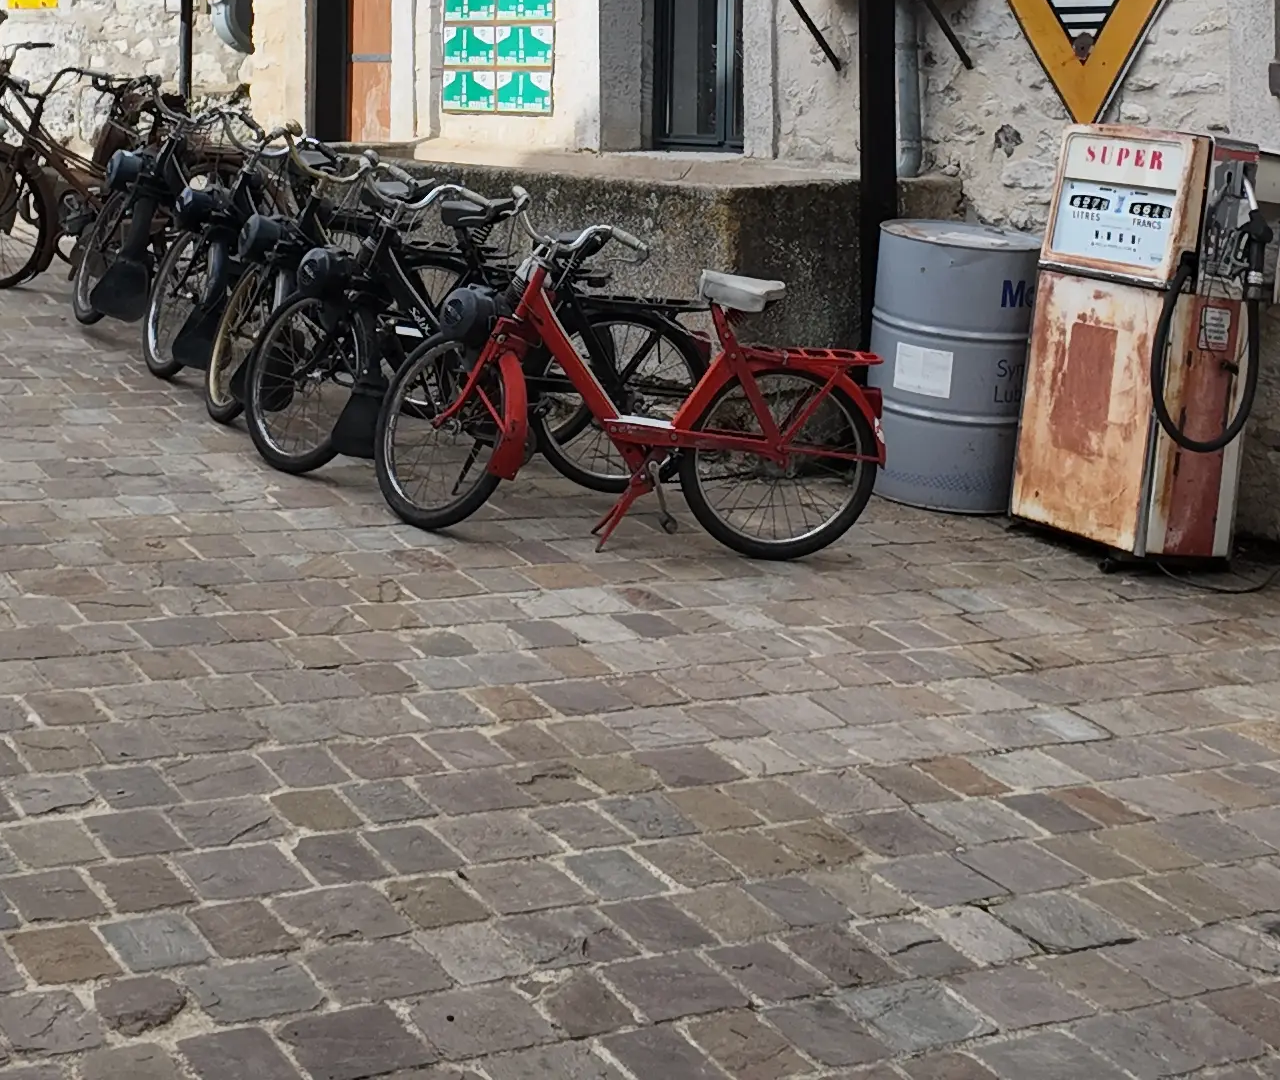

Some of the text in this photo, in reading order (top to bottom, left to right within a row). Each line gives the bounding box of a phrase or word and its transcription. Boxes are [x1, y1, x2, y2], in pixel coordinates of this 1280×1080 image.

[1086, 145, 1163, 170] SUPER
[1073, 210, 1101, 222] LITRES
[1132, 218, 1162, 230] FRANCS
